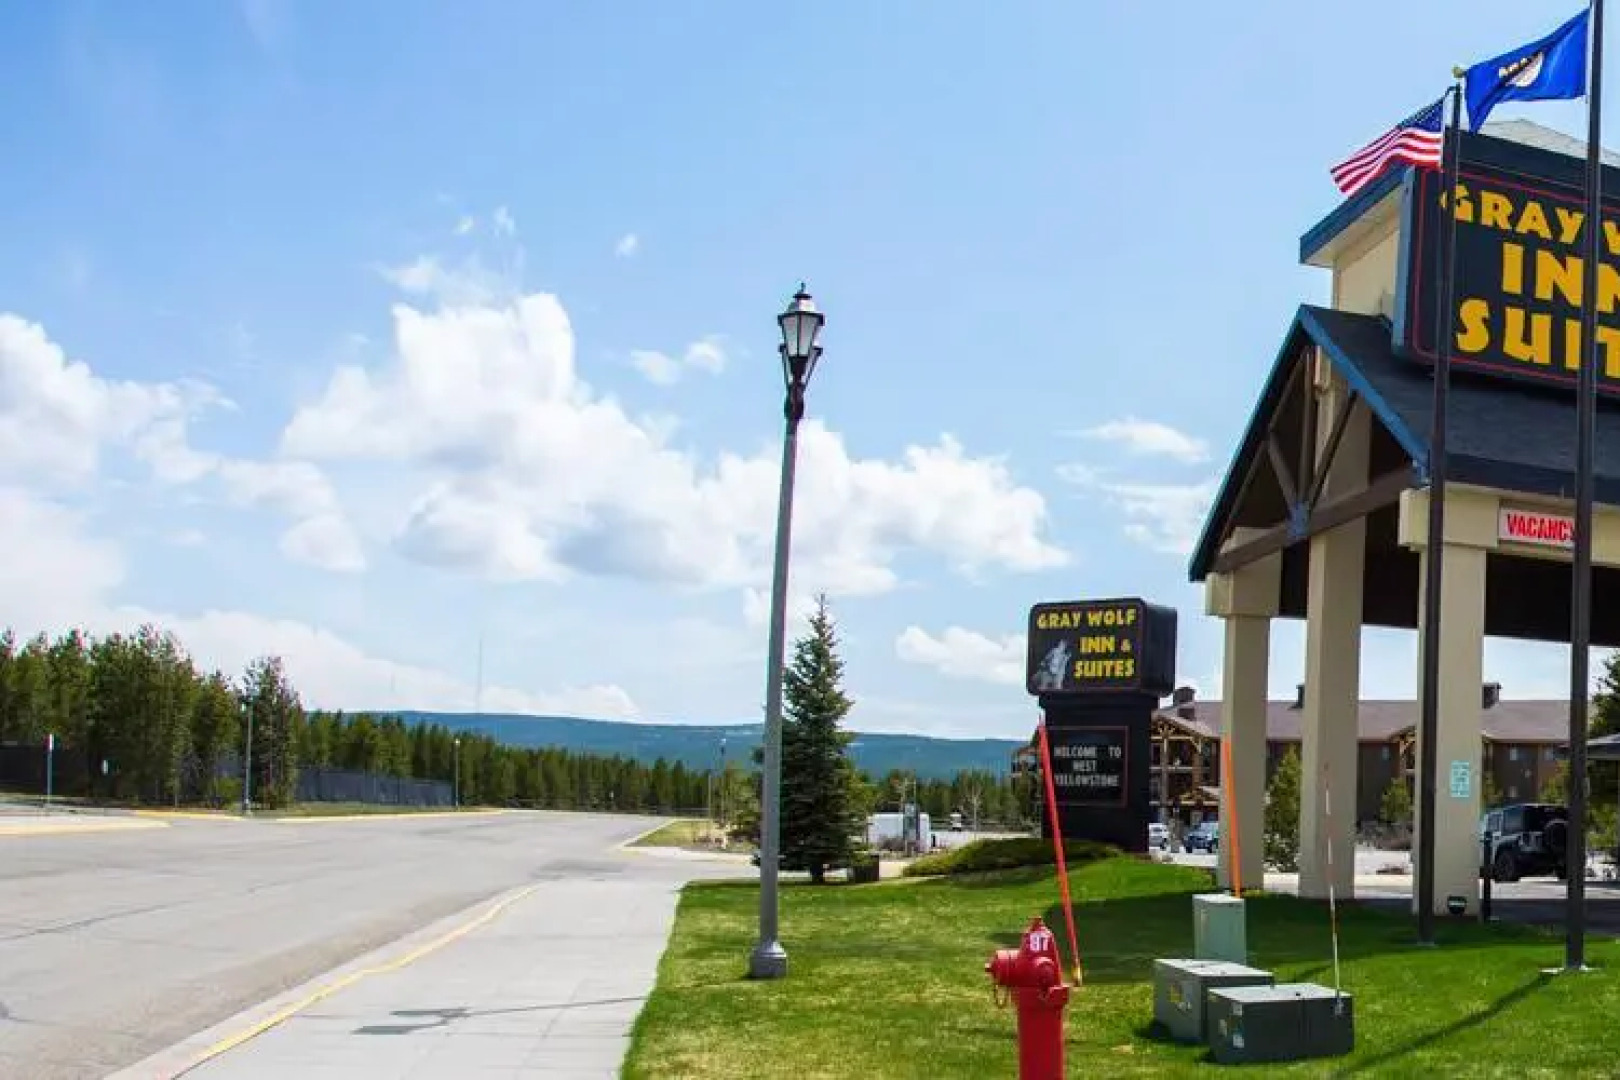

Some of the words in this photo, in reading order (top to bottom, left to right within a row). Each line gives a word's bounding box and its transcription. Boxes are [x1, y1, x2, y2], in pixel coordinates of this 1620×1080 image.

[1440, 183, 1586, 245] GRAY
[1037, 612, 1081, 629] GRAY
[1087, 608, 1136, 627] WOLF
[1080, 635, 1115, 653] INN
[1074, 659, 1134, 678] SUITES
[1054, 746, 1097, 758] WELCOME
[1107, 746, 1121, 758] TO
[1073, 760, 1096, 771] WEST
[1054, 774, 1119, 786] YELLOWSTONE
